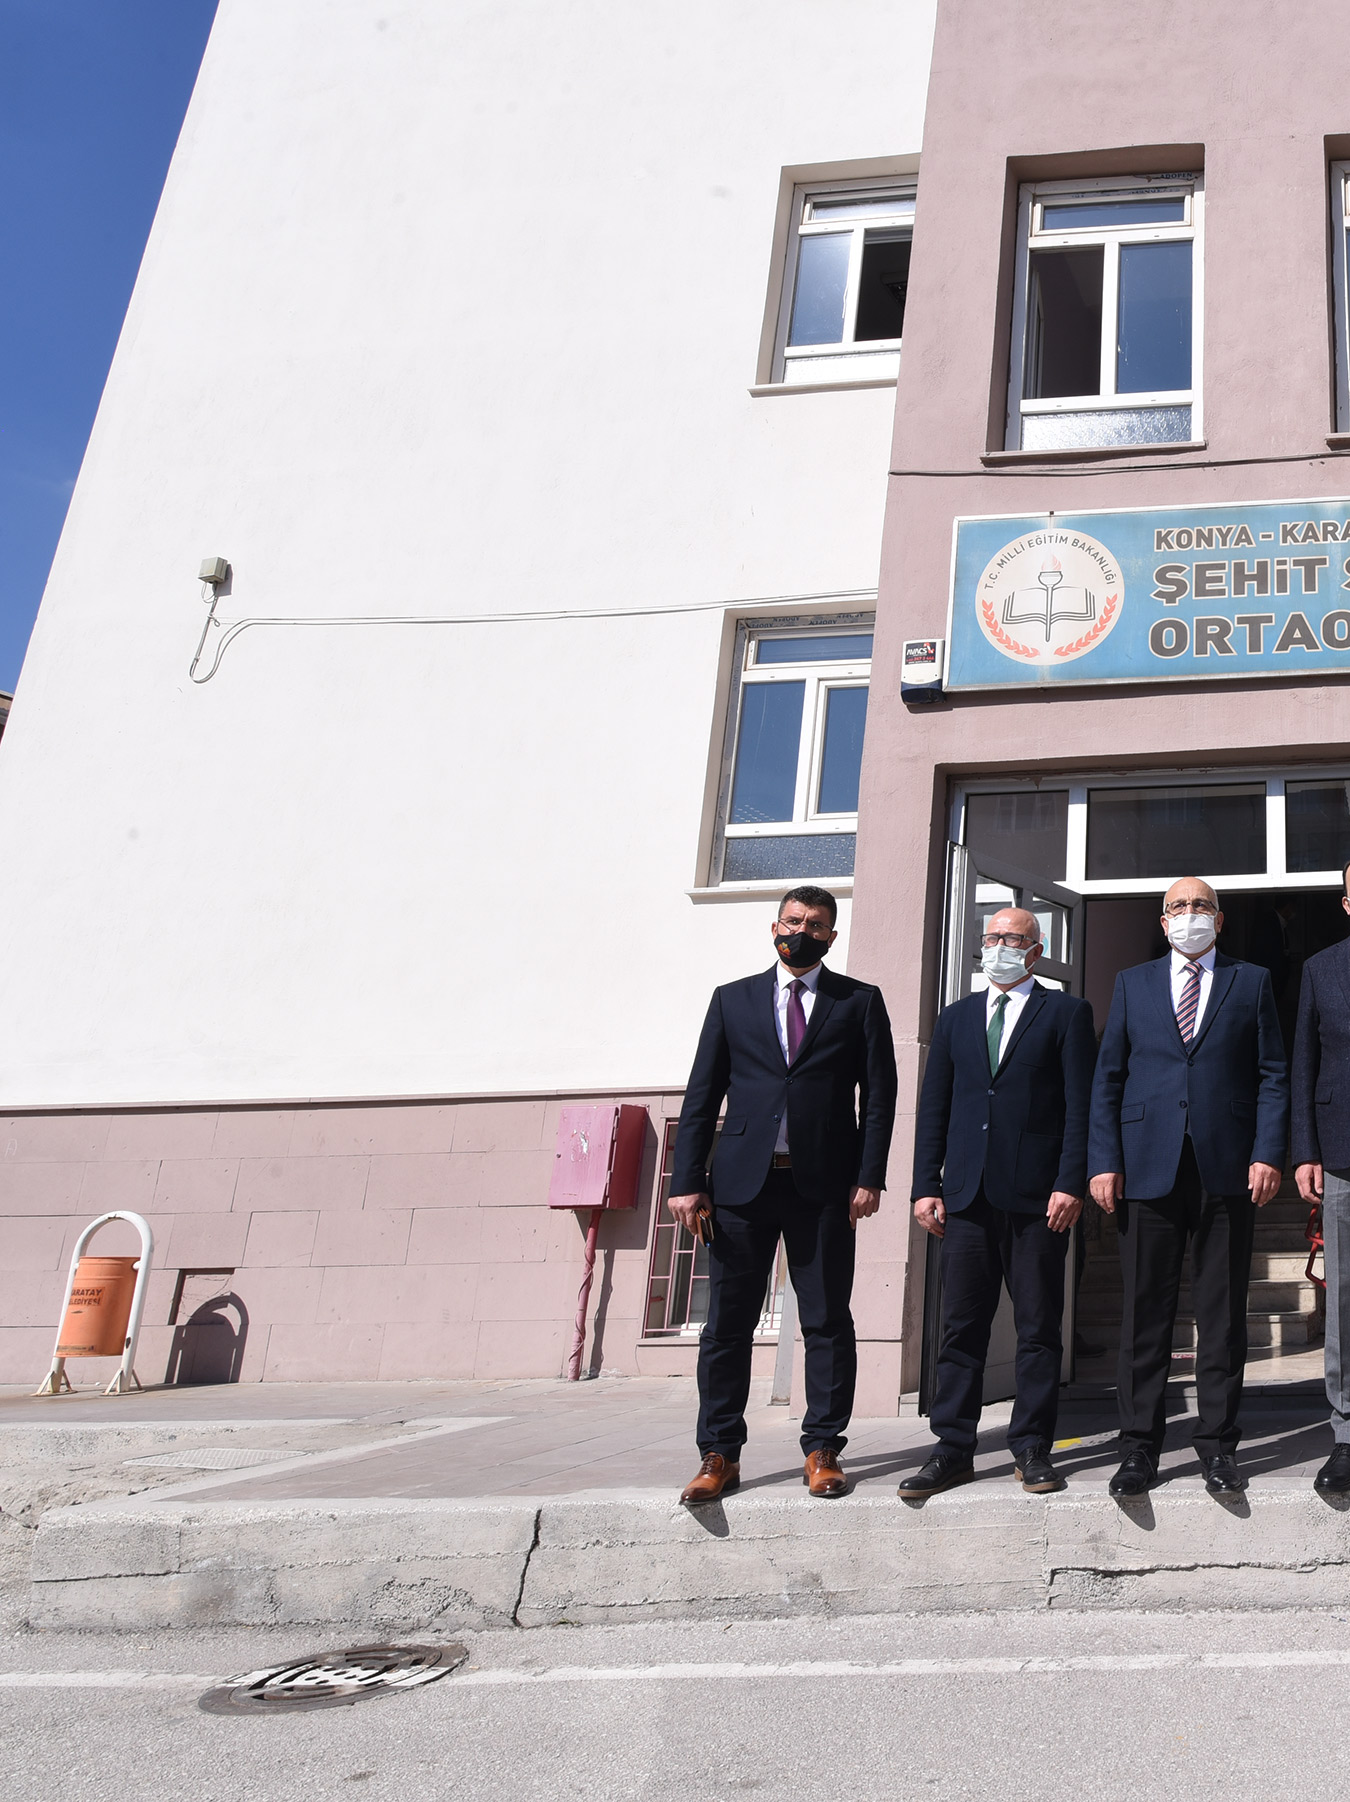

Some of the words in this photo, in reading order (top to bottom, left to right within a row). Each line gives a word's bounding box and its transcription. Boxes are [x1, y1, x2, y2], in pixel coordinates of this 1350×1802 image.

[1154, 523, 1256, 552] KONYA
[984, 571, 1001, 590] T.C.
[997, 541, 1026, 569] MİLLİ
[1027, 533, 1069, 549] EĞİTİM
[1071, 538, 1117, 585] BAKANLIĞI
